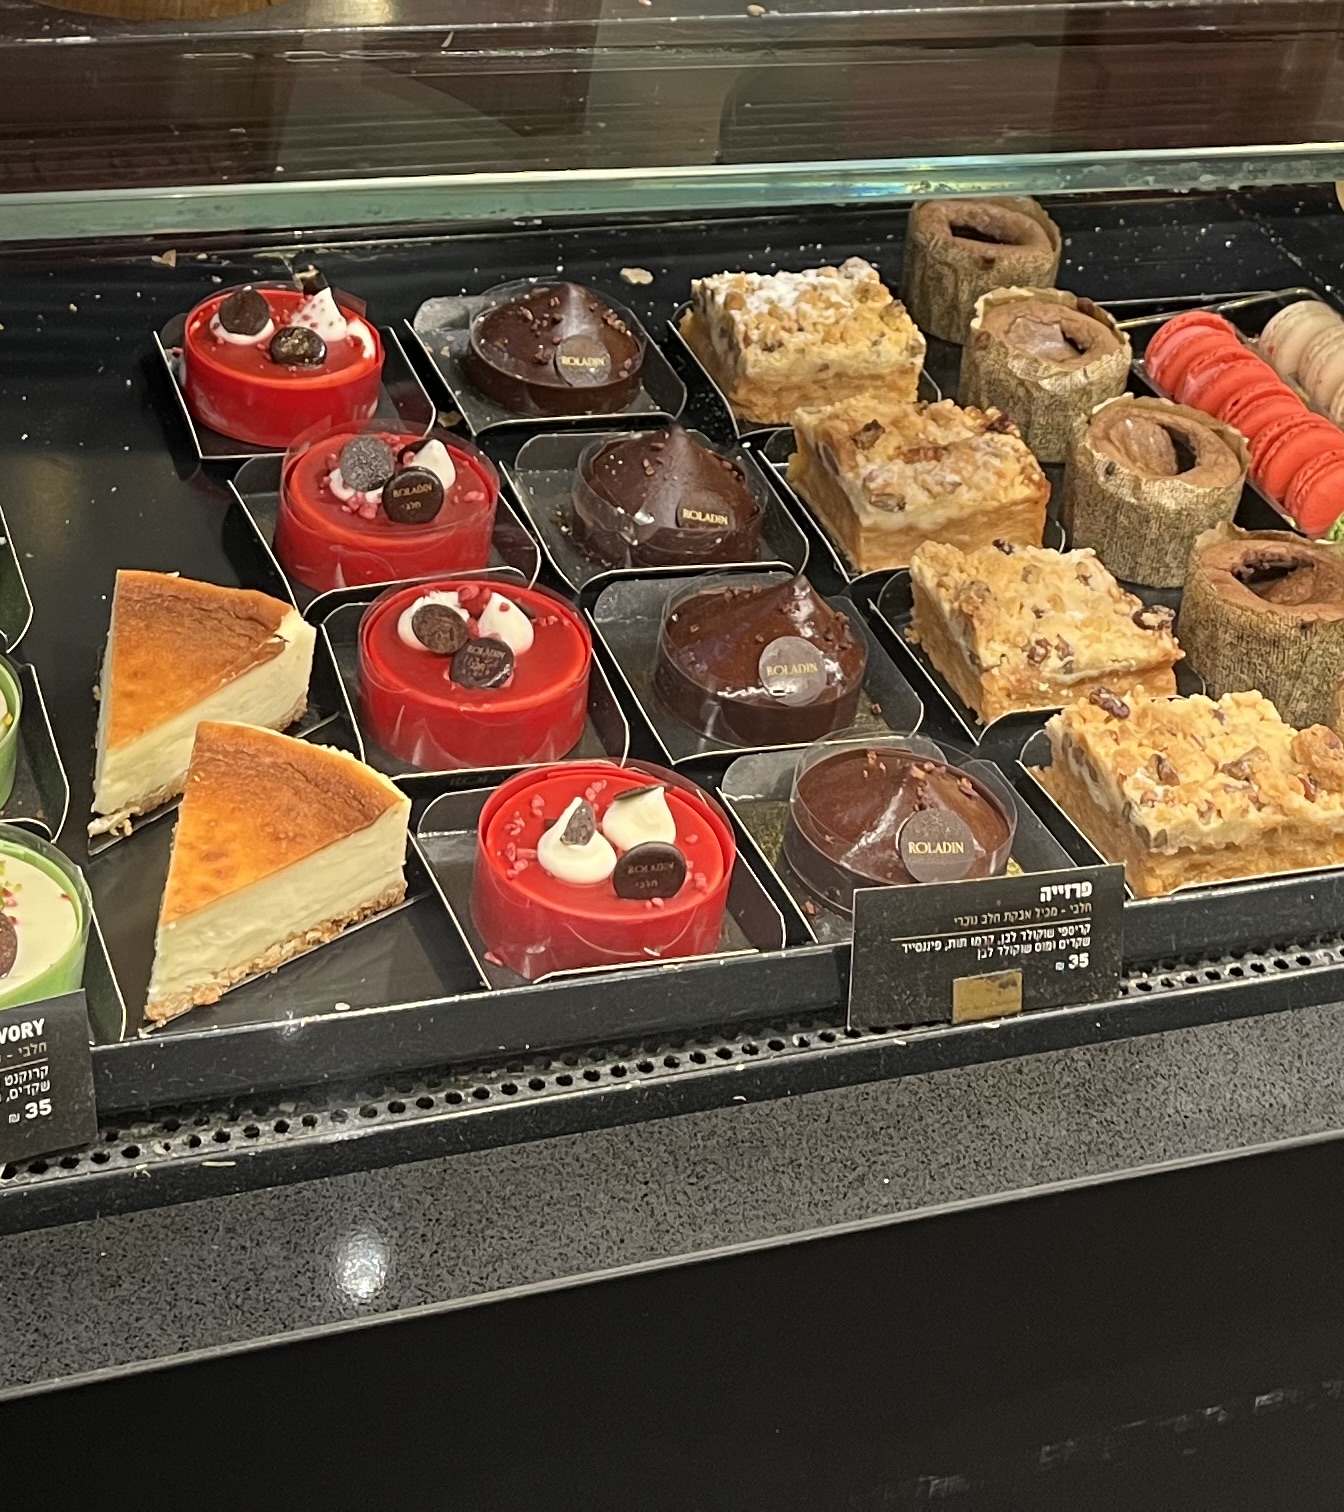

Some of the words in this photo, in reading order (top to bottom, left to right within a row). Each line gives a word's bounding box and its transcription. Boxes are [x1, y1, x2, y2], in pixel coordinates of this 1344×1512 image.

[682, 508, 729, 526] ROLADIN
[766, 662, 819, 678] ROLADIN
[908, 840, 964, 855] ROLADIN
[1040, 882, 1092, 902] פרזייה
[1068, 953, 1089, 968] 35
[25, 1101, 52, 1120] 35
